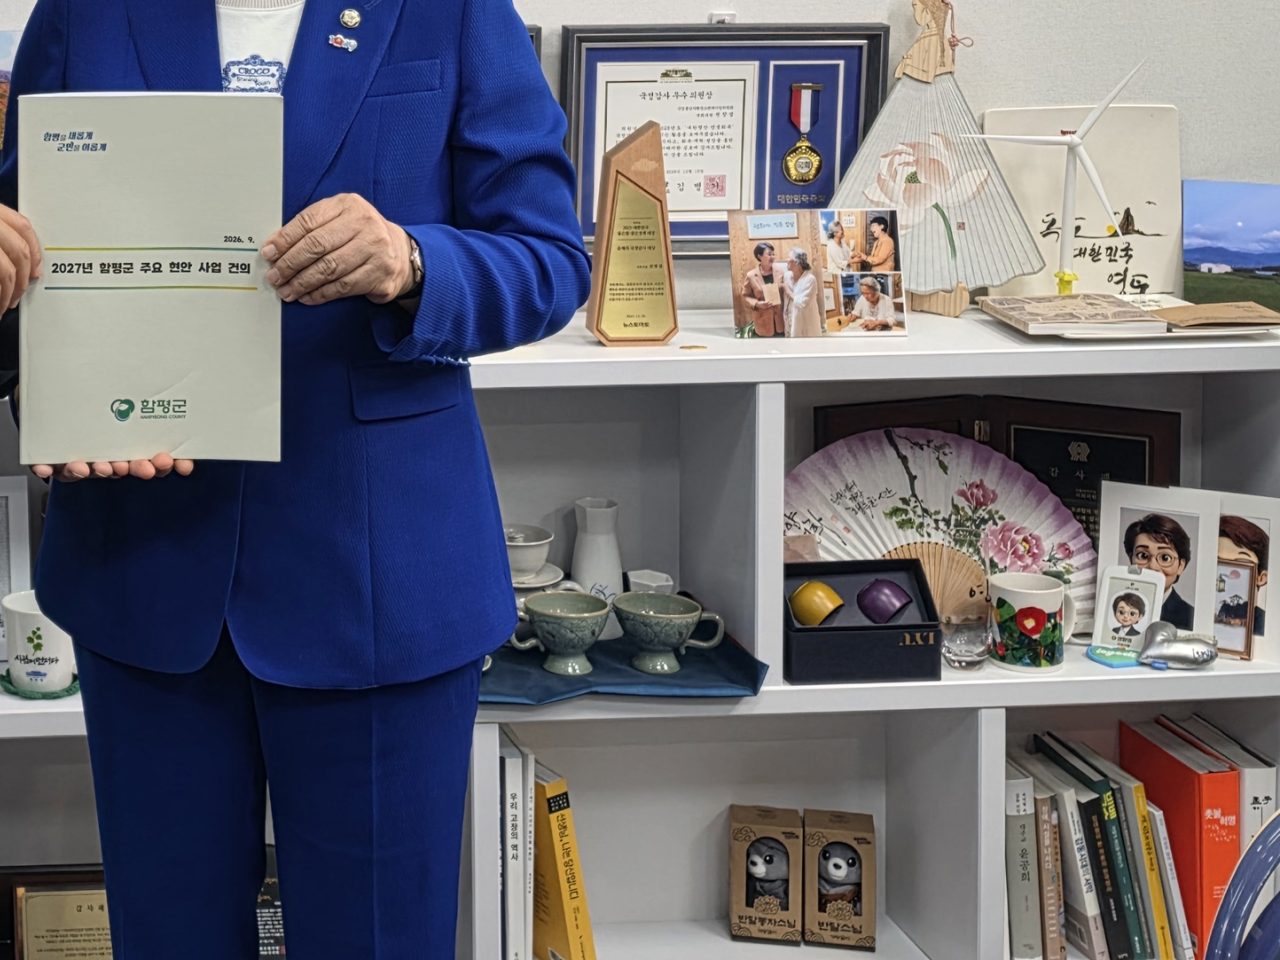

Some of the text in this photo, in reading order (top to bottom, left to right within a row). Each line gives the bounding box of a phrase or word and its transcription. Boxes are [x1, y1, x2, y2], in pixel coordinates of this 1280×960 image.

[223, 235, 245, 244] 2026.
[1073, 241, 1134, 265] 대한민국
[51, 261, 252, 275] 2027년 함평군 주요 현안 사업 건의
[140, 399, 187, 414] 함평군
[509, 792, 519, 862] 우리 고장의 역사
[563, 858, 580, 901] 당신입니다
[817, 921, 863, 934] 반달스님
